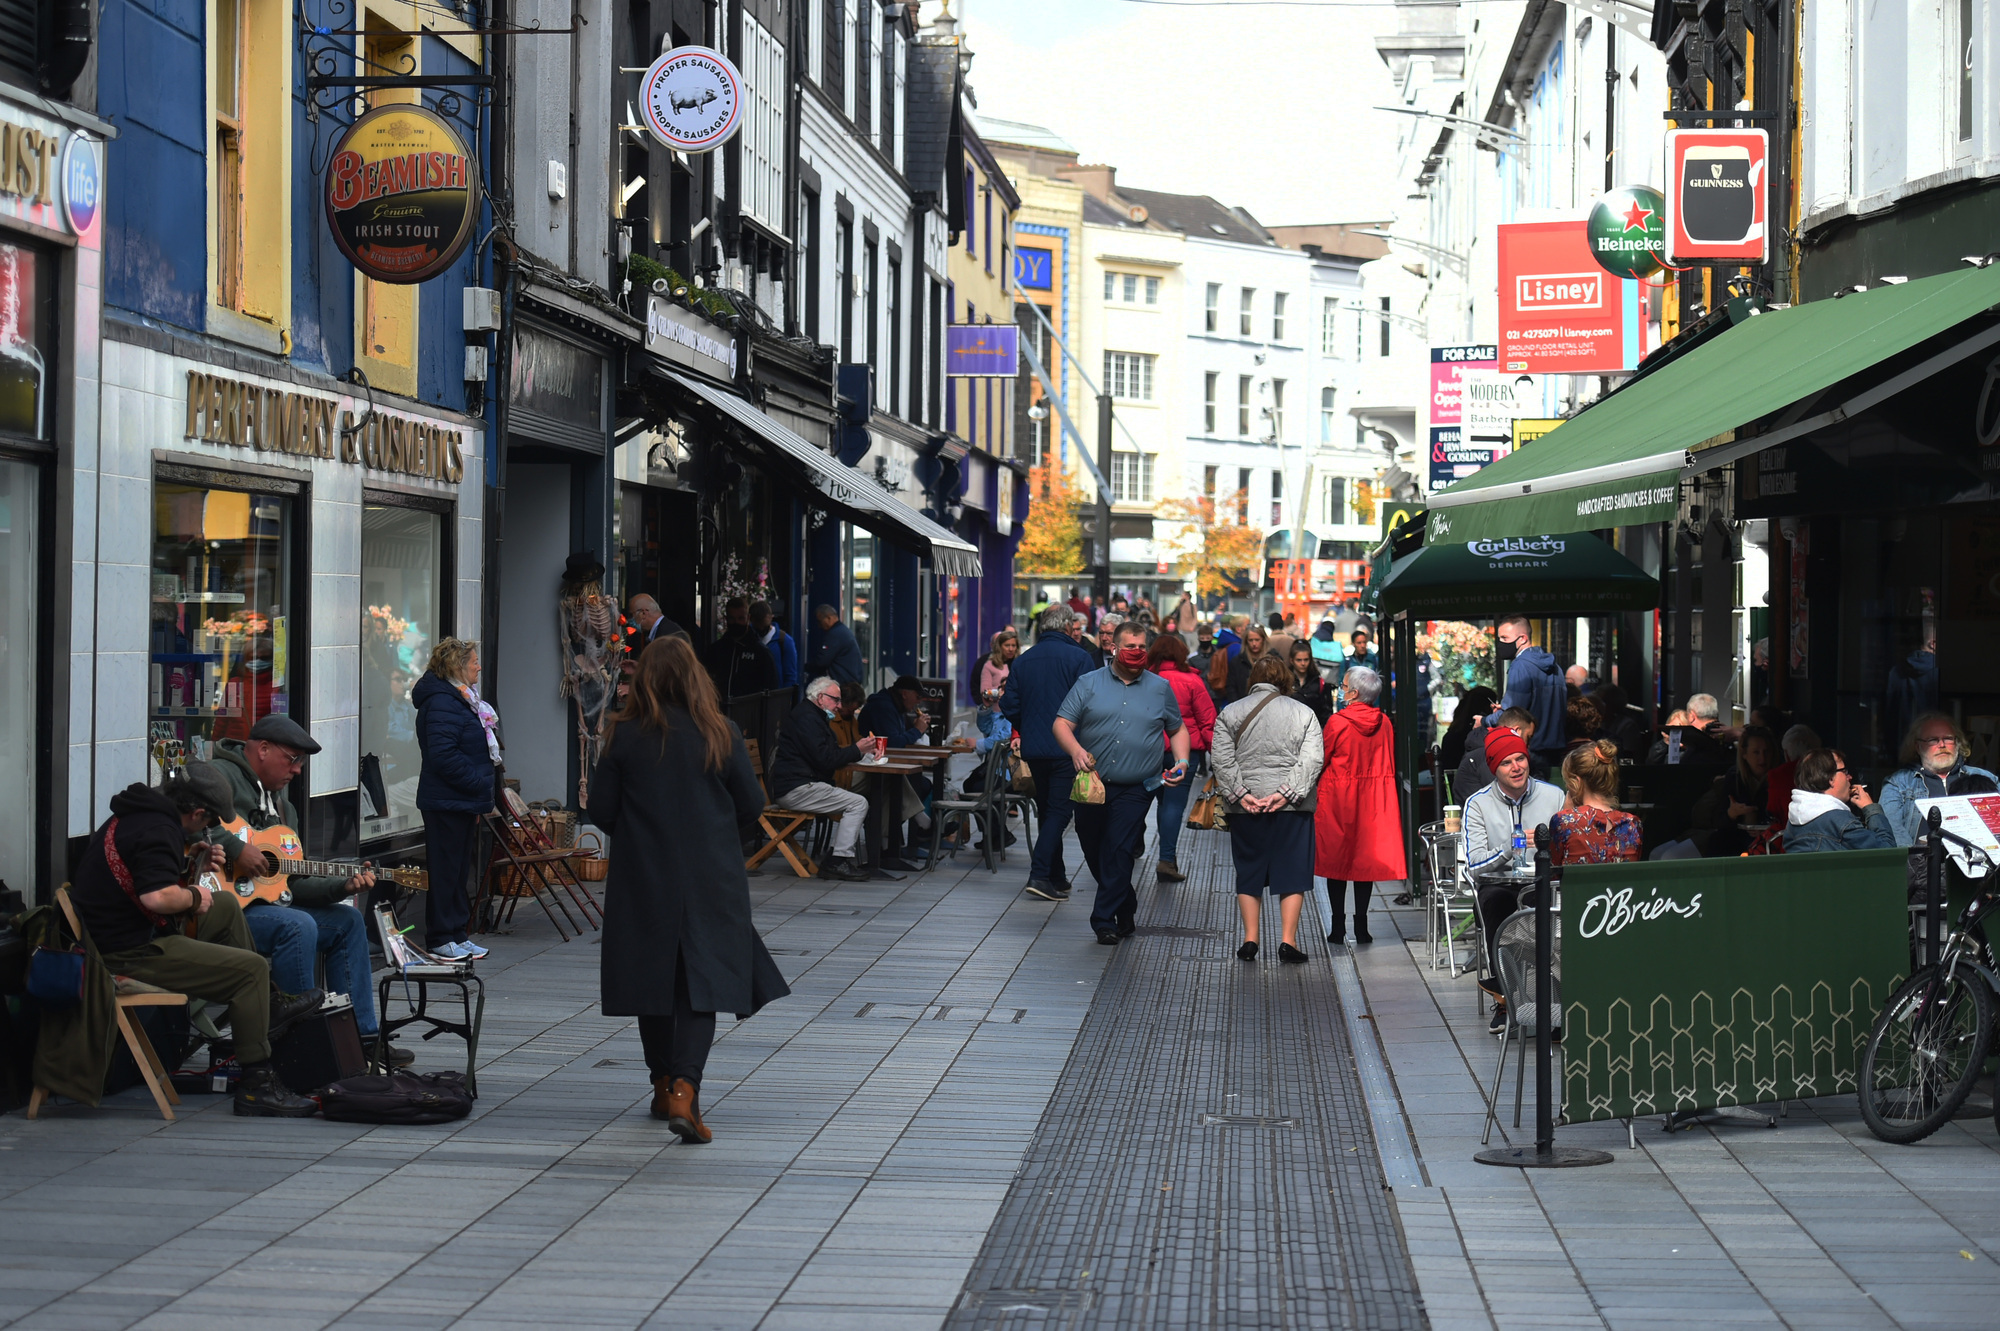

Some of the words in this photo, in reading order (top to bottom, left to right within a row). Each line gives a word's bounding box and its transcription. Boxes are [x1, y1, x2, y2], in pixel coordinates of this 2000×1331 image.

[654, 59, 688, 90] PROPER
[690, 58, 732, 96] SAUSAGES
[653, 104, 682, 137] PROPER
[683, 109, 730, 140] SAUSAGES
[71, 159, 95, 208] life
[331, 151, 467, 212] BEAMISH
[1689, 178, 1744, 188] GUINNESS
[368, 203, 425, 221] Genuine
[355, 224, 392, 238] IRISH
[396, 224, 440, 239] STOUT
[1597, 237, 1665, 252] Heineke
[1522, 280, 1596, 303] Lisney
[1506, 330, 1520, 339] 021
[1522, 328, 1560, 339] 4275079
[953, 344, 1008, 360] Hallmark
[1442, 349, 1466, 361] FOR
[1466, 347, 1495, 360] SALE
[1507, 344, 1536, 352] GROUND
[1536, 343, 1557, 351] FLOOR
[1557, 342, 1578, 350] RETAIL
[184, 369, 340, 460] PERFUMERY
[340, 410, 360, 465] &
[361, 410, 465, 485] COSMETICS
[1432, 442, 1448, 463] &
[1447, 451, 1490, 462] GOSLING
[1758, 471, 1799, 497] WHOLESOME
[1576, 495, 1614, 516] HANDCRAFTED
[1614, 489, 1648, 510] SANDWICHES
[1653, 486, 1675, 504] COFFEE
[1467, 535, 1566, 560] Carlsberg
[1489, 560, 1549, 569] DENMARK
[1410, 596, 1460, 607] PROBABLY
[1463, 595, 1482, 604] THE
[1486, 594, 1510, 604] BEST
[1531, 593, 1557, 601] BEER
[1560, 593, 1572, 601] IN
[1575, 592, 1594, 601] THE
[1596, 591, 1632, 601] WORLD
